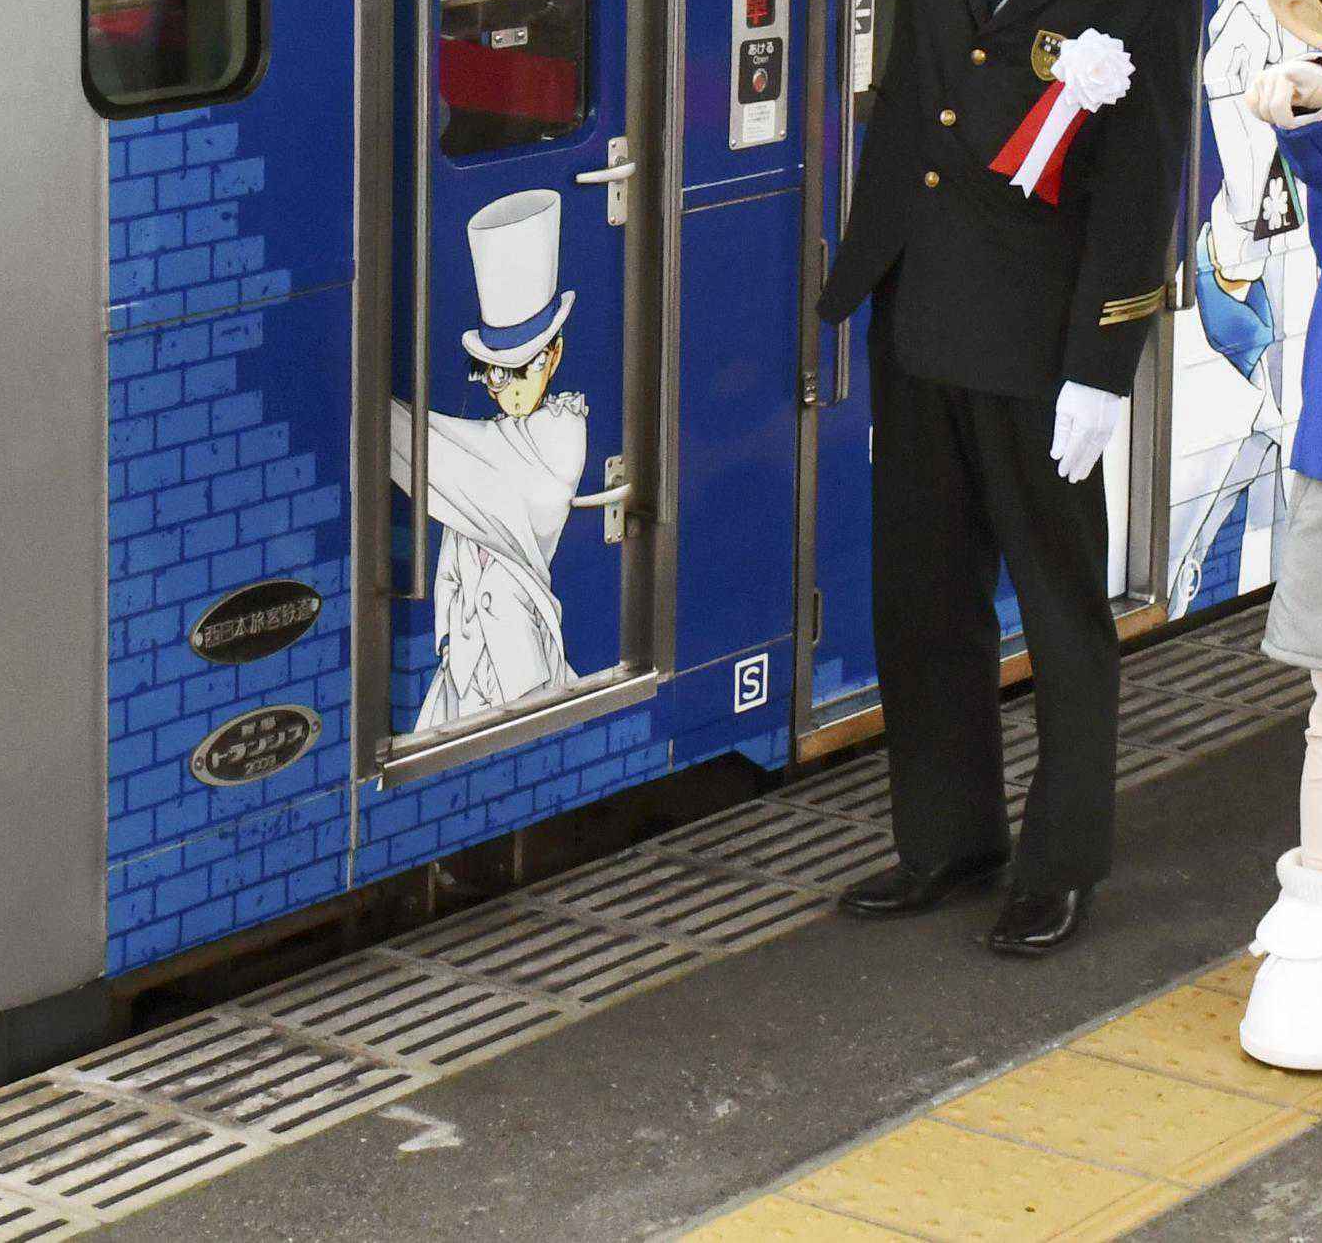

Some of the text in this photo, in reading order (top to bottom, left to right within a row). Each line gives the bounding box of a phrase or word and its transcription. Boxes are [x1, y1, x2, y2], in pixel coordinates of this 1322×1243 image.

[748, 41, 775, 56] あける
[742, 665, 760, 700] S
